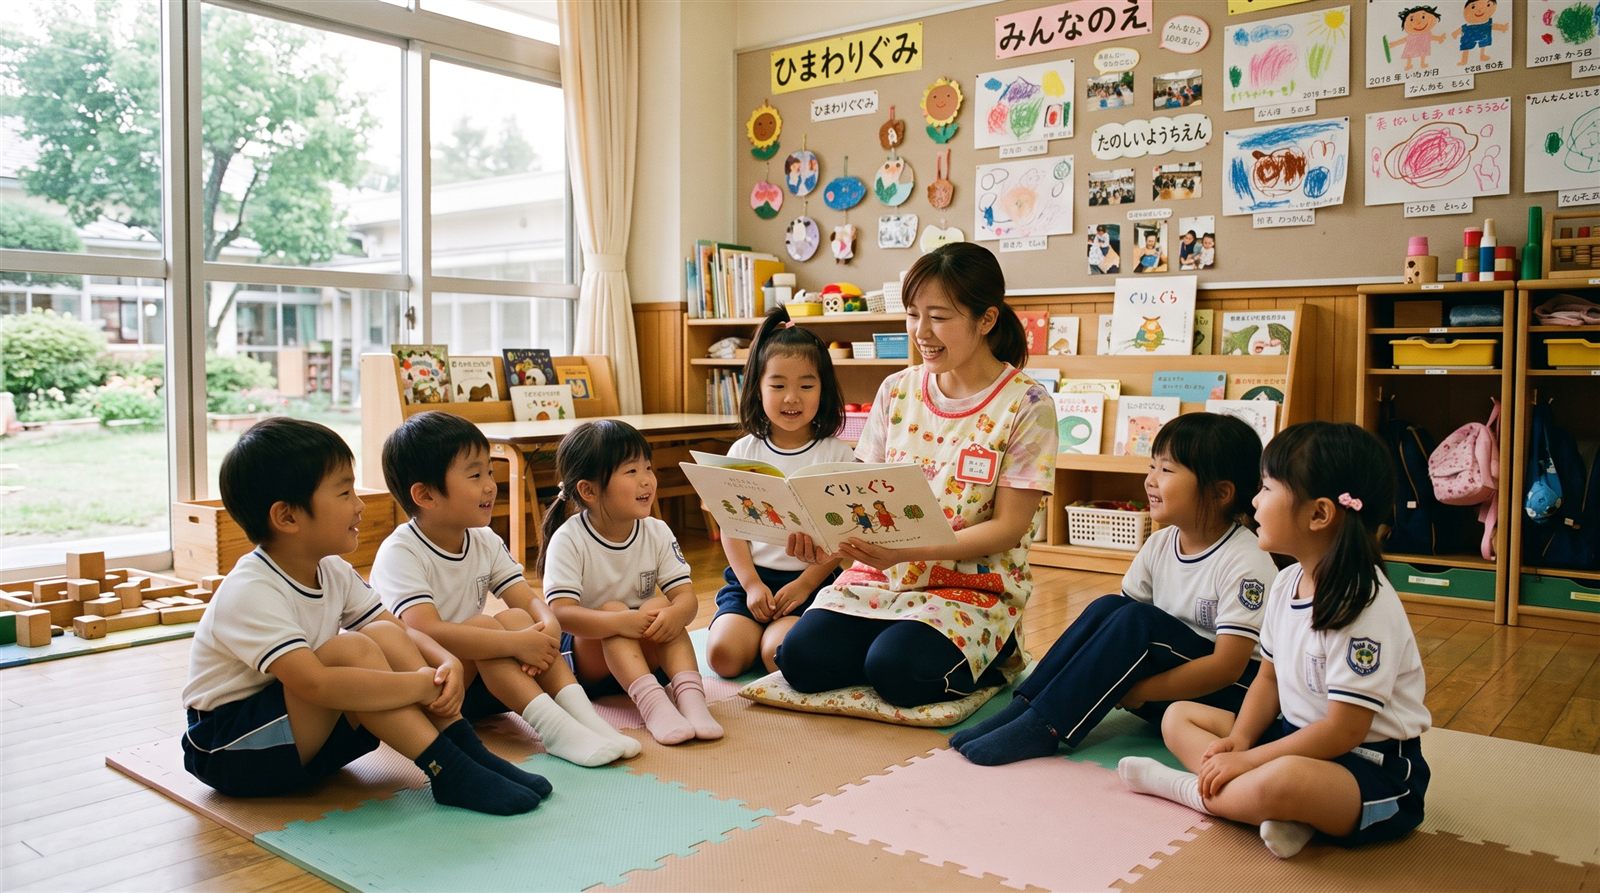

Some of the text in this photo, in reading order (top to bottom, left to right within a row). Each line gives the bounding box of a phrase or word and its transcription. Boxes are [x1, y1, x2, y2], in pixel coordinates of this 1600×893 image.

[999, 0, 1148, 51] みんなのえ
[774, 32, 918, 86] ひまわりぐみ
[1369, 76, 1391, 86] 2018
[814, 98, 874, 117] ひまわりぐぐみ
[1097, 122, 1206, 151] たのしいようちえん
[1129, 290, 1177, 304] ぐりとぐら
[824, 479, 895, 497] ぐりとぐら
